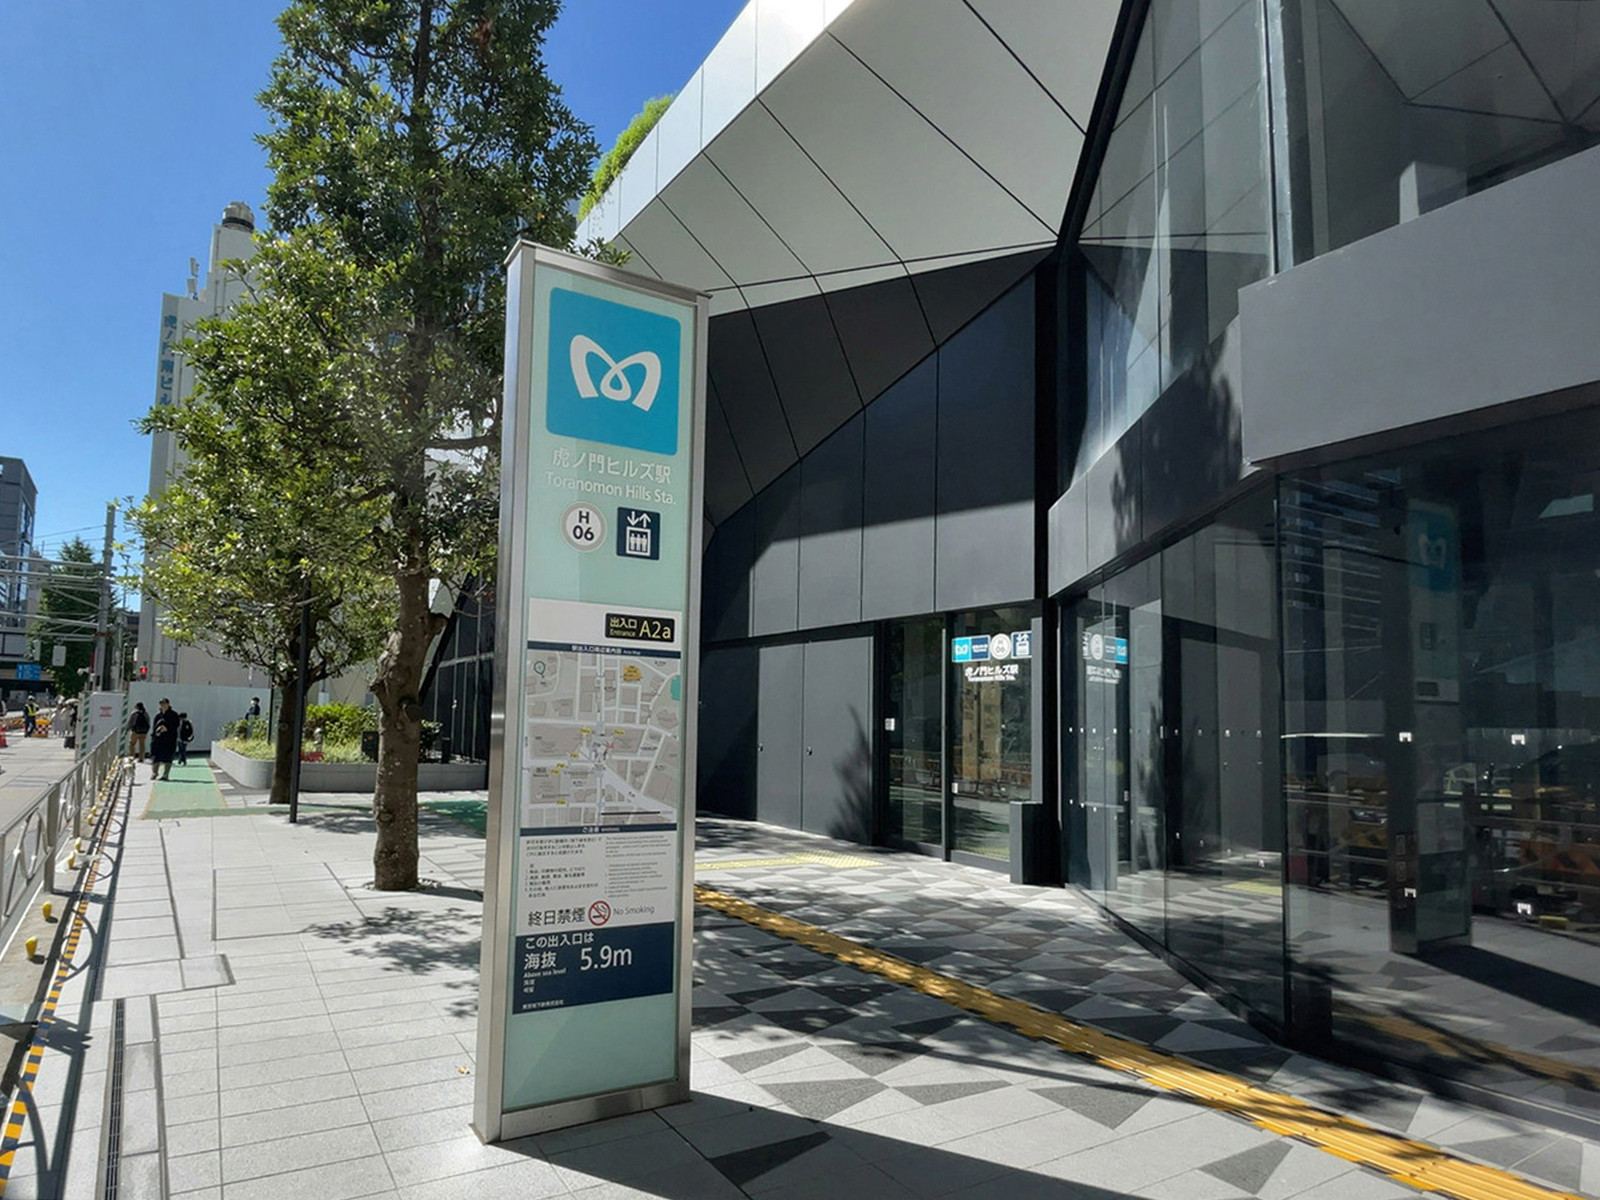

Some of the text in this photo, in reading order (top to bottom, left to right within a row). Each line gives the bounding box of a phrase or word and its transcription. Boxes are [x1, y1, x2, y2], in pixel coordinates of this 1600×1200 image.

[553, 447, 671, 485] 虎ノ門ヒルズ駅
[545, 472, 676, 505] Toranomon Hills Sta.
[579, 511, 589, 524] H
[572, 525, 594, 541] 06
[609, 616, 637, 629] 出入口
[639, 621, 671, 639] A2a
[609, 629, 636, 638] Entrance
[528, 907, 586, 927] 終日禁煙
[613, 905, 656, 916] No Smoking
[525, 932, 594, 949] この出入口は
[524, 945, 632, 971] 海抜 5.9m
